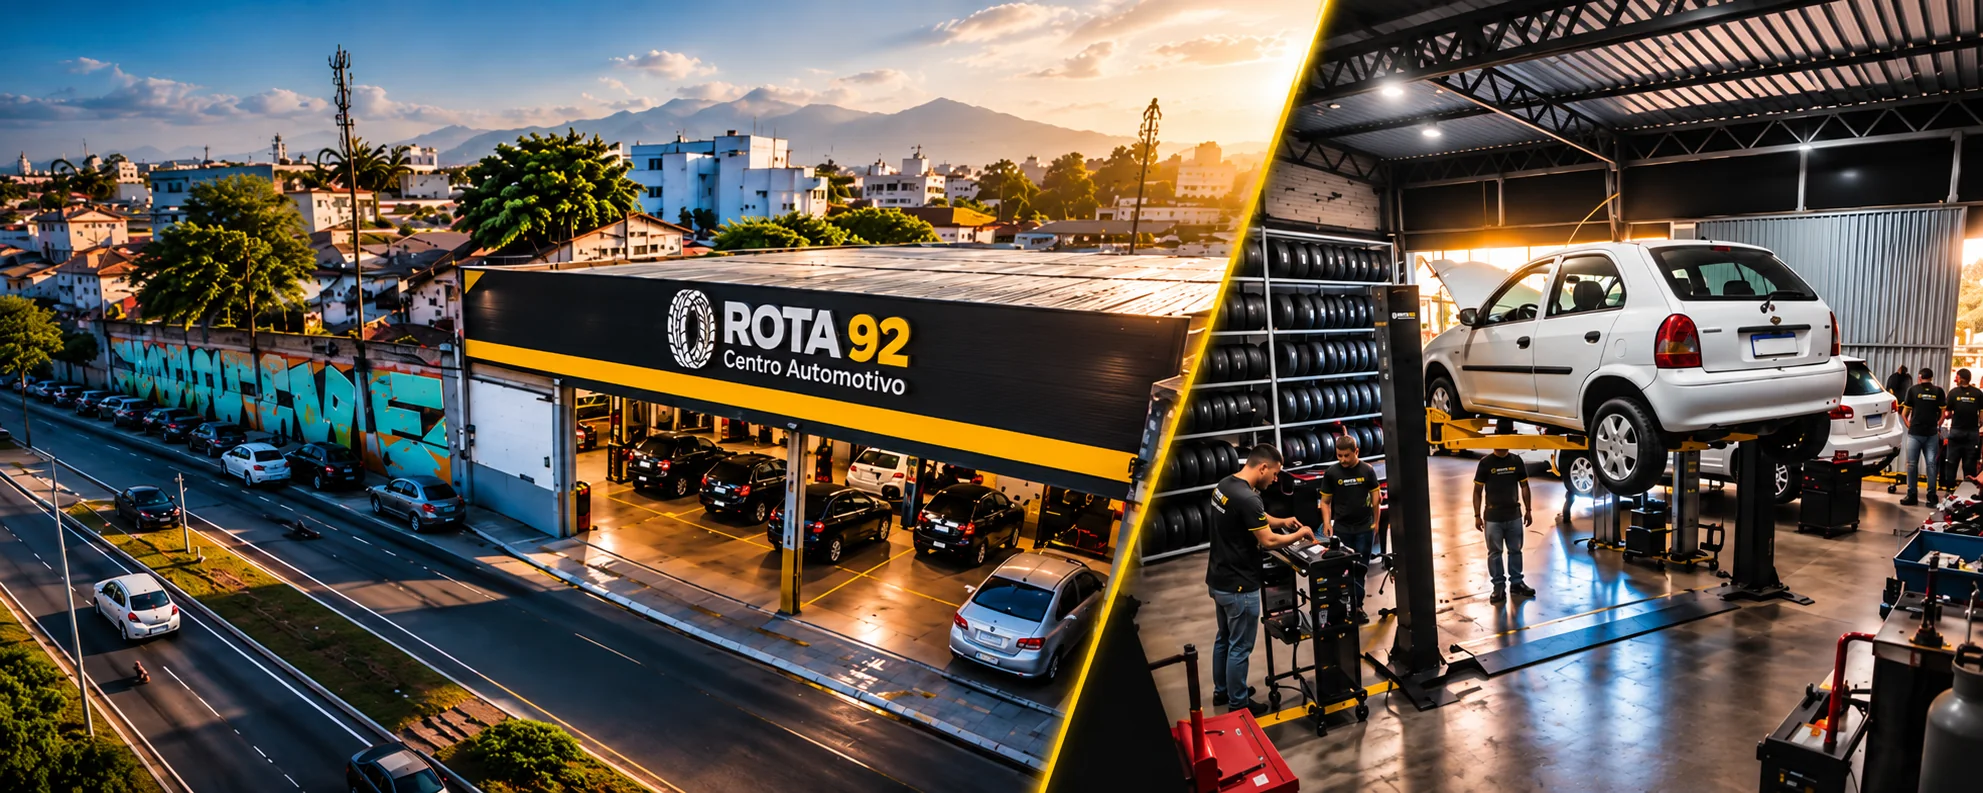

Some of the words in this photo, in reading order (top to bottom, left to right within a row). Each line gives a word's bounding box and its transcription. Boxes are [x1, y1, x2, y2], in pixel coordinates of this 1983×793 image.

[724, 300, 842, 359] ROTA
[848, 313, 912, 368] 92
[723, 349, 782, 376] Centro
[786, 358, 906, 396] Automotivo
